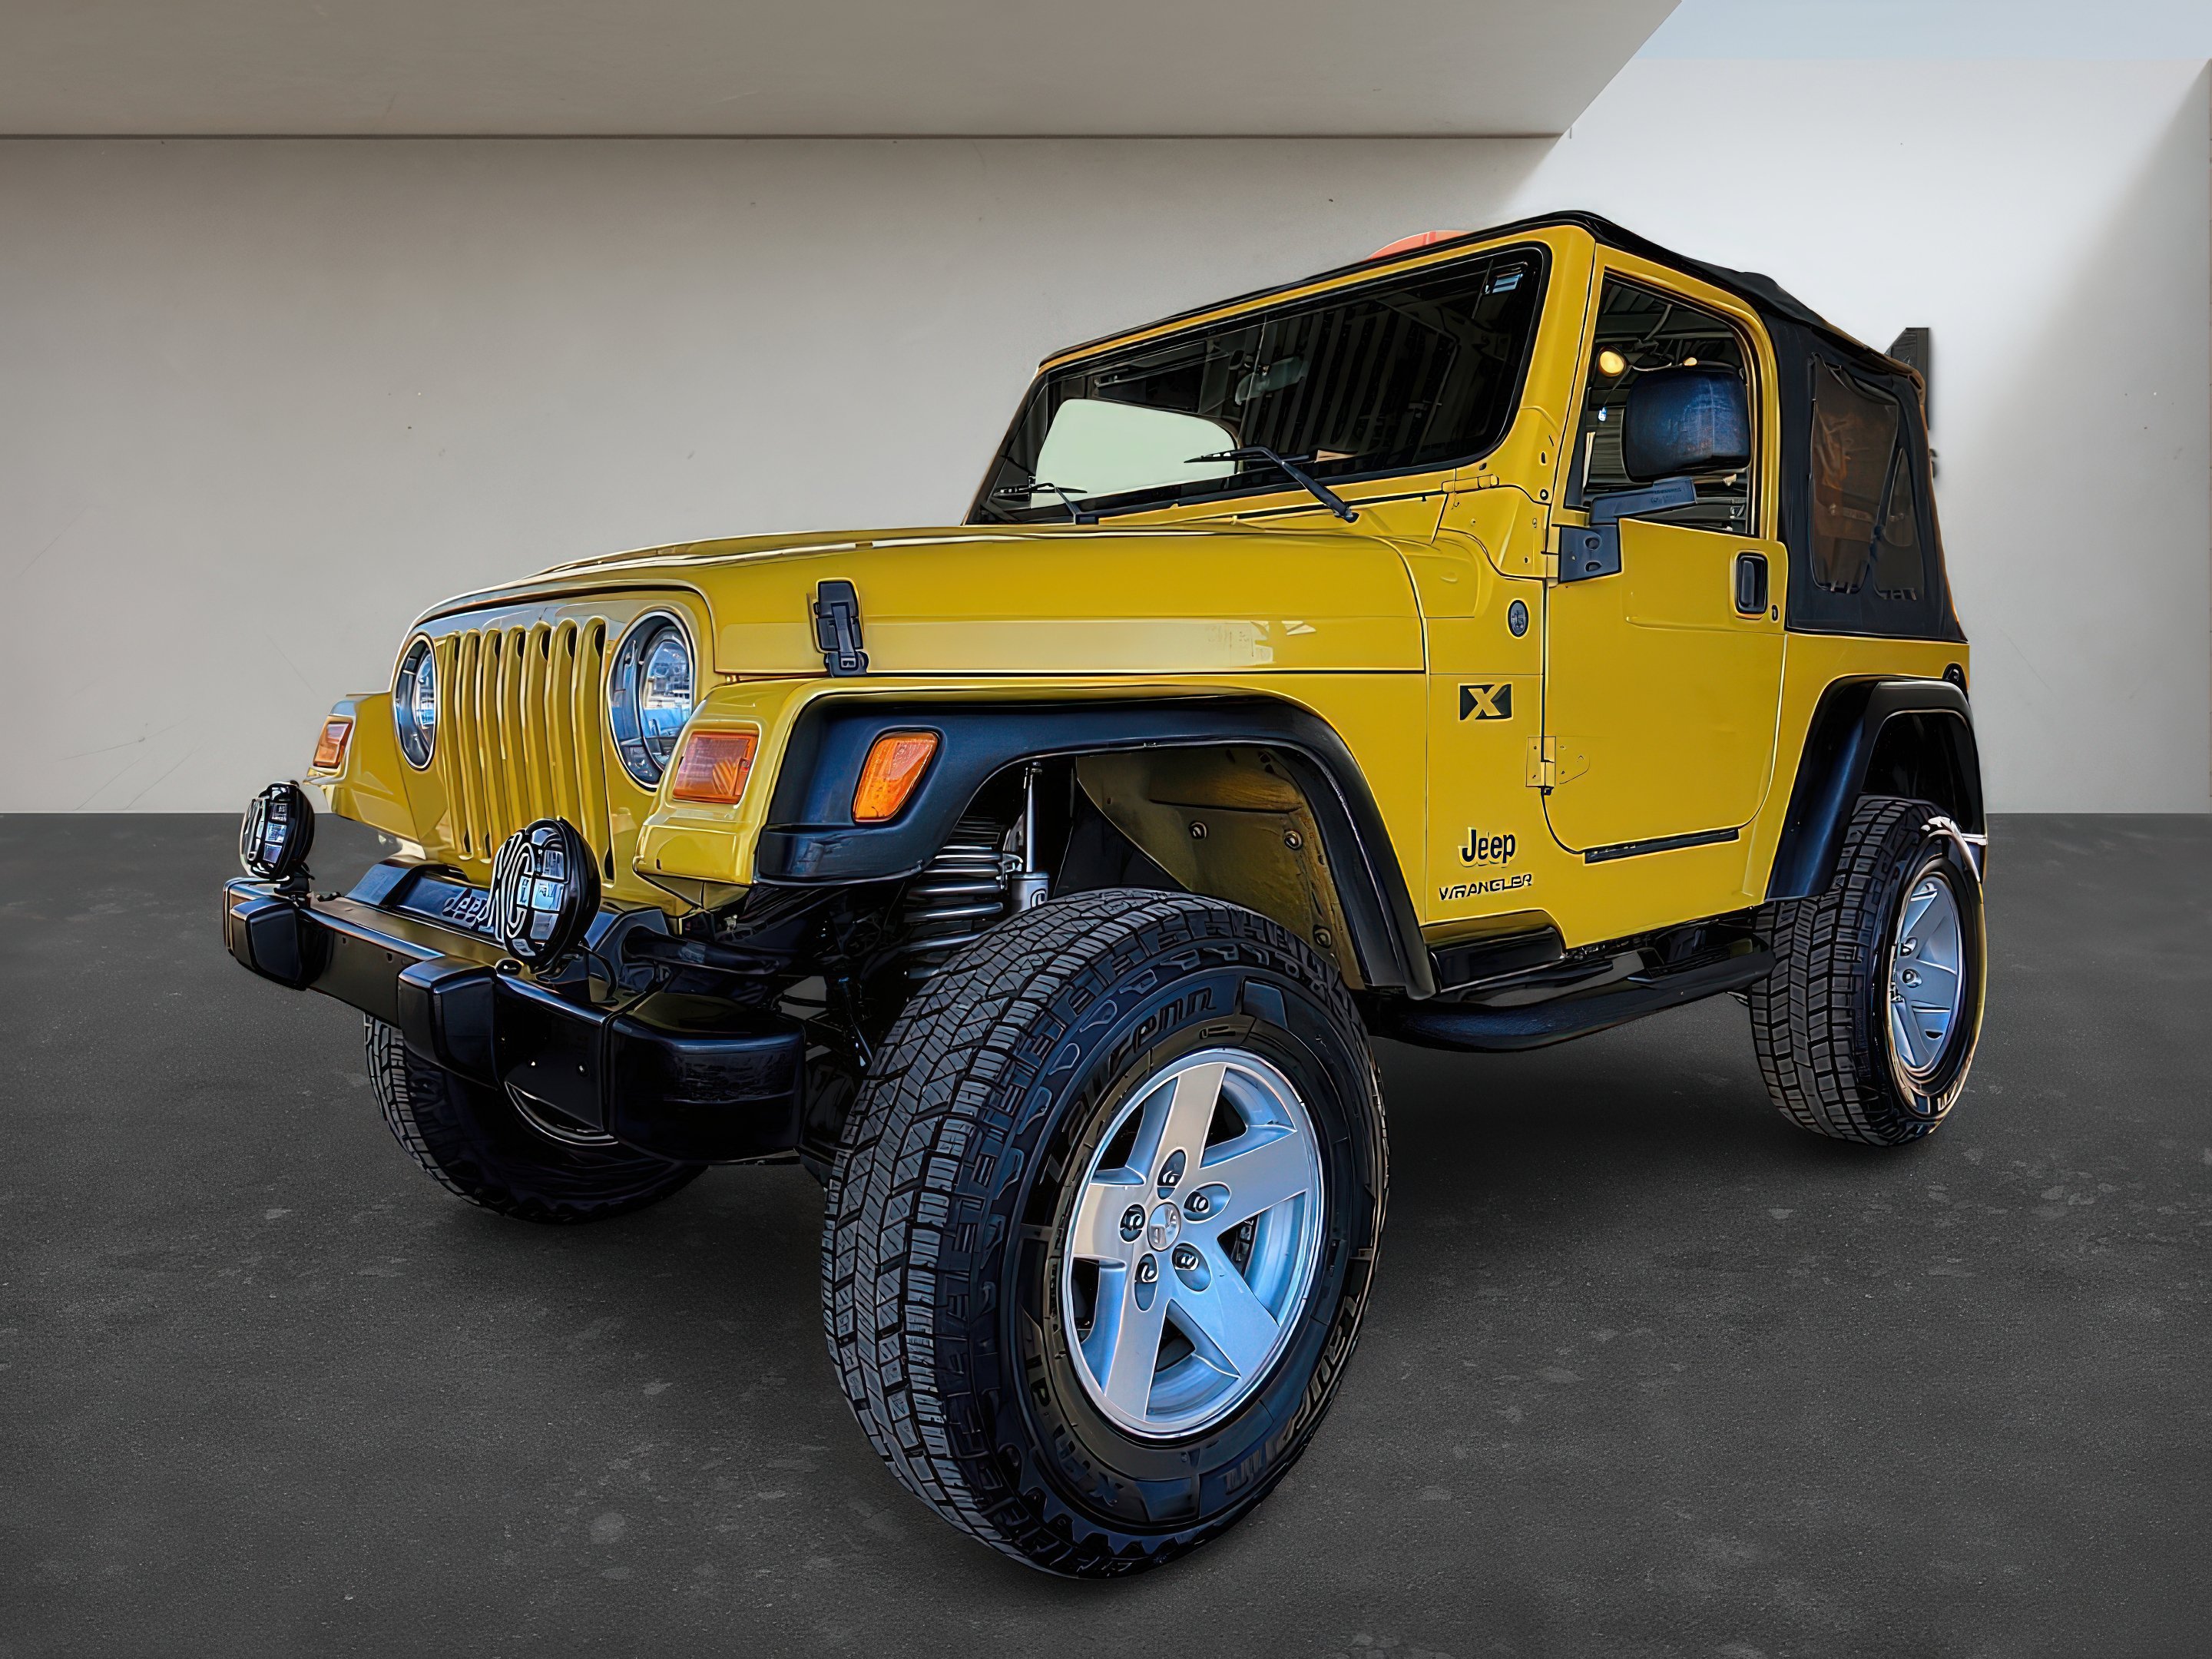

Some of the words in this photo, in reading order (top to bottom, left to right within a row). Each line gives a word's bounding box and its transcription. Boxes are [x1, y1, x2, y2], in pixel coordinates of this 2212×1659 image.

[1462, 683, 1506, 720] X
[1462, 829, 1516, 864] Jeep
[1439, 873, 1532, 900] WRANGLER
